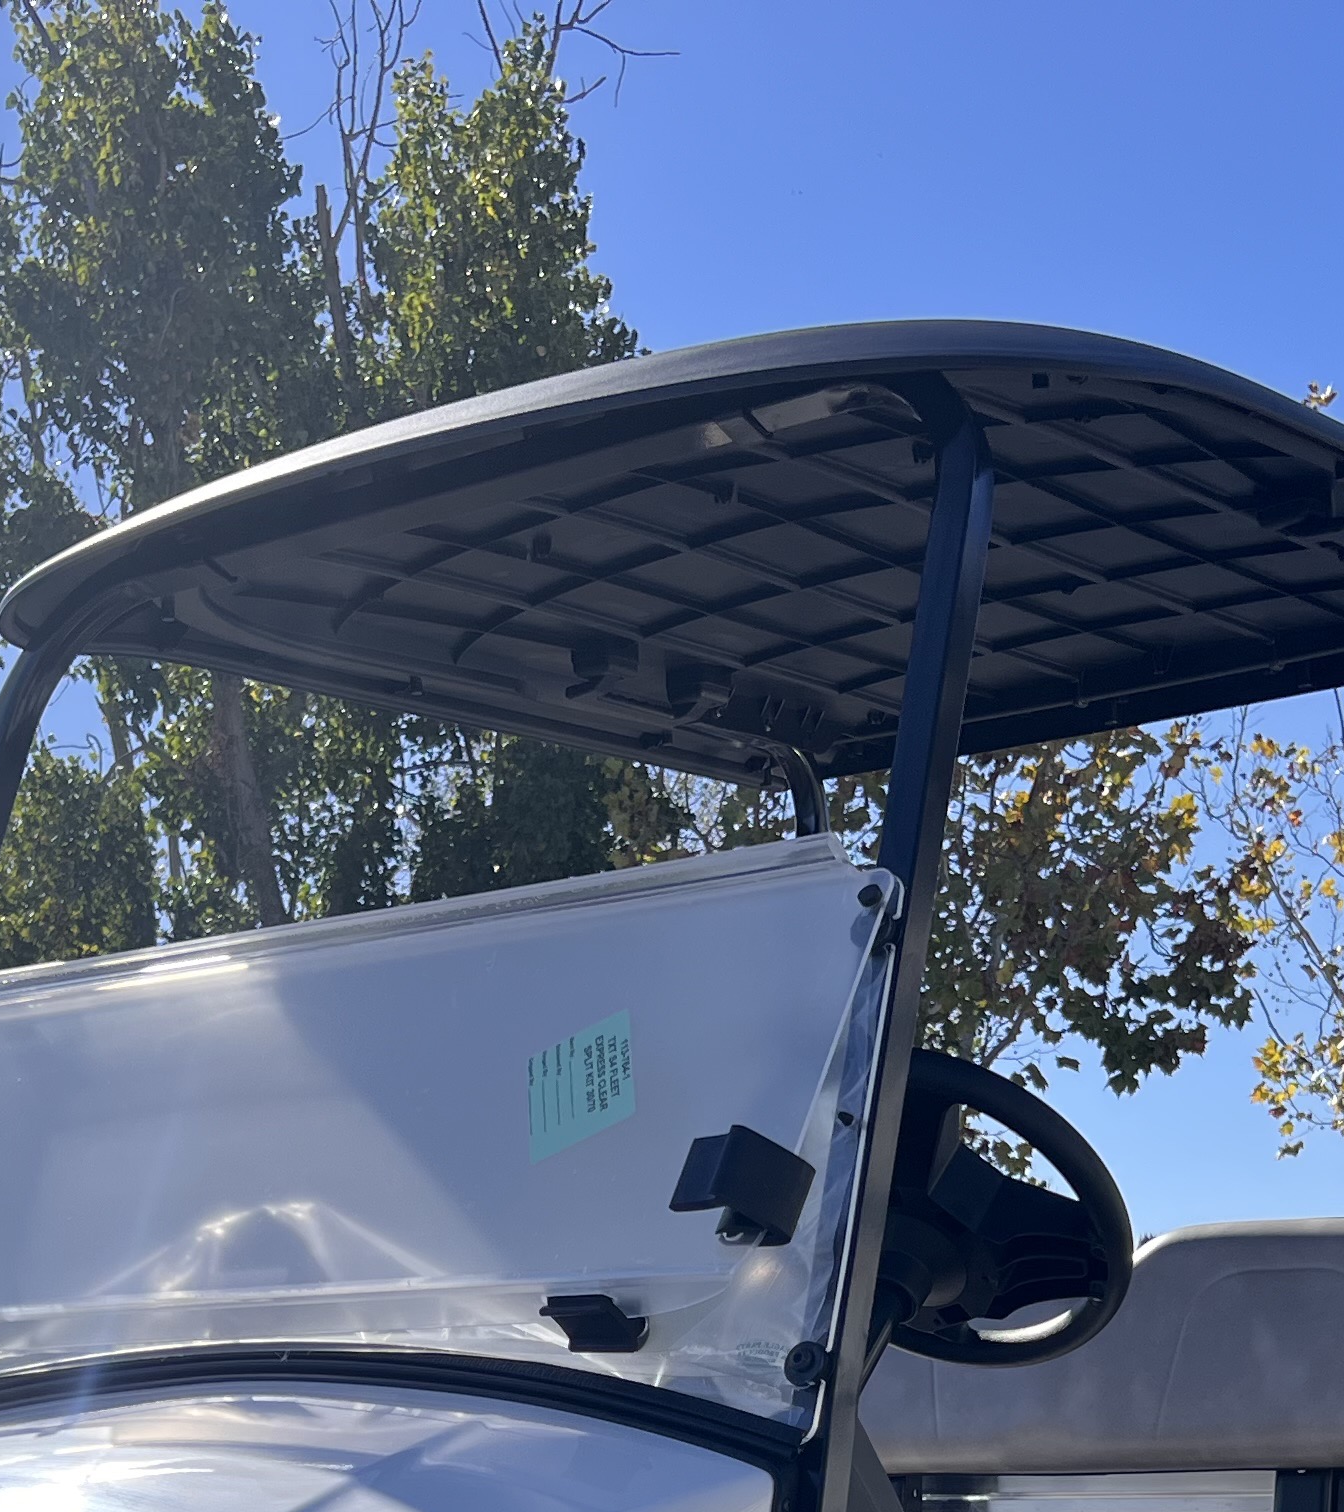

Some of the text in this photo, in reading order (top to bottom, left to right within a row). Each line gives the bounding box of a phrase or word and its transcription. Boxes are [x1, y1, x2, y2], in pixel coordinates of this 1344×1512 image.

[607, 1035, 617, 1053] TXT
[584, 1045, 594, 1071] SPLIT
[585, 1073, 594, 1087] KIT
[594, 1035, 608, 1112] EXPRESS CLEAR
[609, 1068, 620, 1097] FLEET
